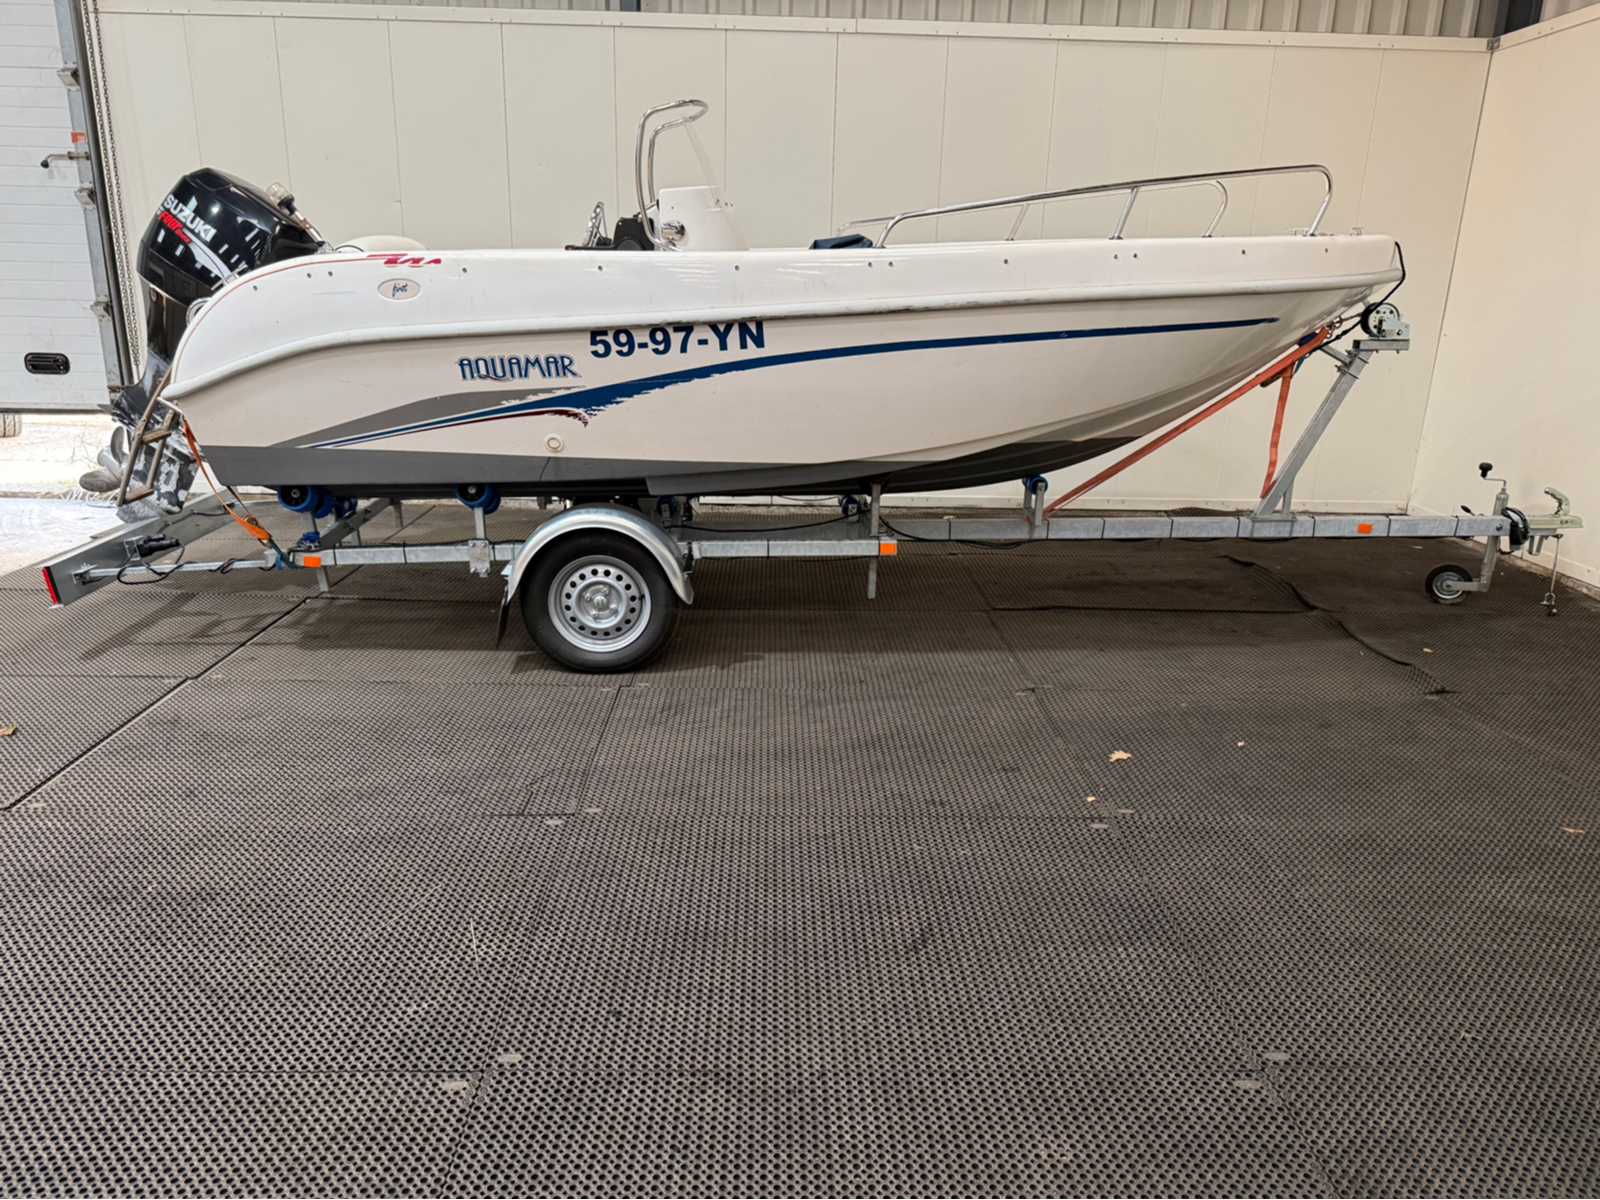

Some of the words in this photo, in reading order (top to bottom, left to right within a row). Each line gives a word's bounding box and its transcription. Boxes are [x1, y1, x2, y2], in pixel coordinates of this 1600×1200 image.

[163, 194, 217, 242] SUZUKI
[589, 320, 765, 358] 59-97-YN
[458, 355, 581, 381] AQUAMAR
